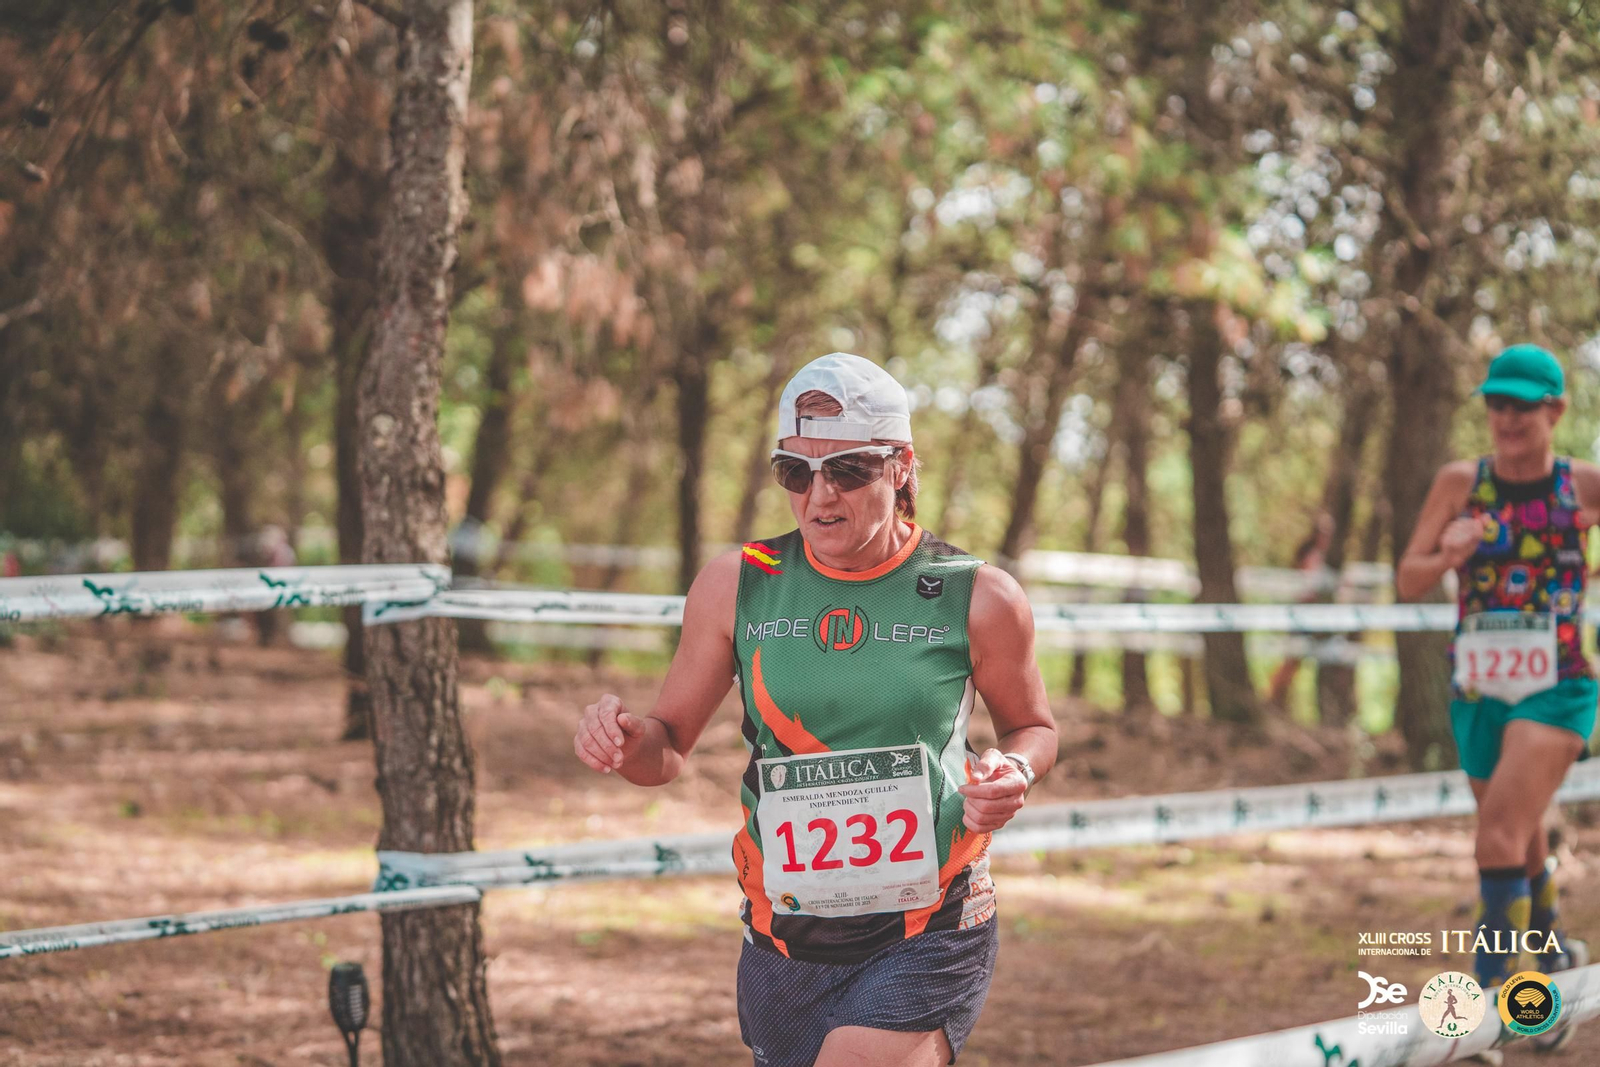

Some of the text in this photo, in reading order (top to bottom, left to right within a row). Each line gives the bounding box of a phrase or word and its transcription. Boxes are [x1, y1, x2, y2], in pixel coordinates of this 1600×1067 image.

[746, 618, 810, 641] MADE
[1465, 647, 1549, 680] 1220
[795, 759, 878, 783] ITÁLICA
[782, 784, 899, 802] ESMERALDA MENDOZA GUILLÉN
[809, 797, 869, 808] INDEPENDIENTE
[776, 808, 924, 873] 1232
